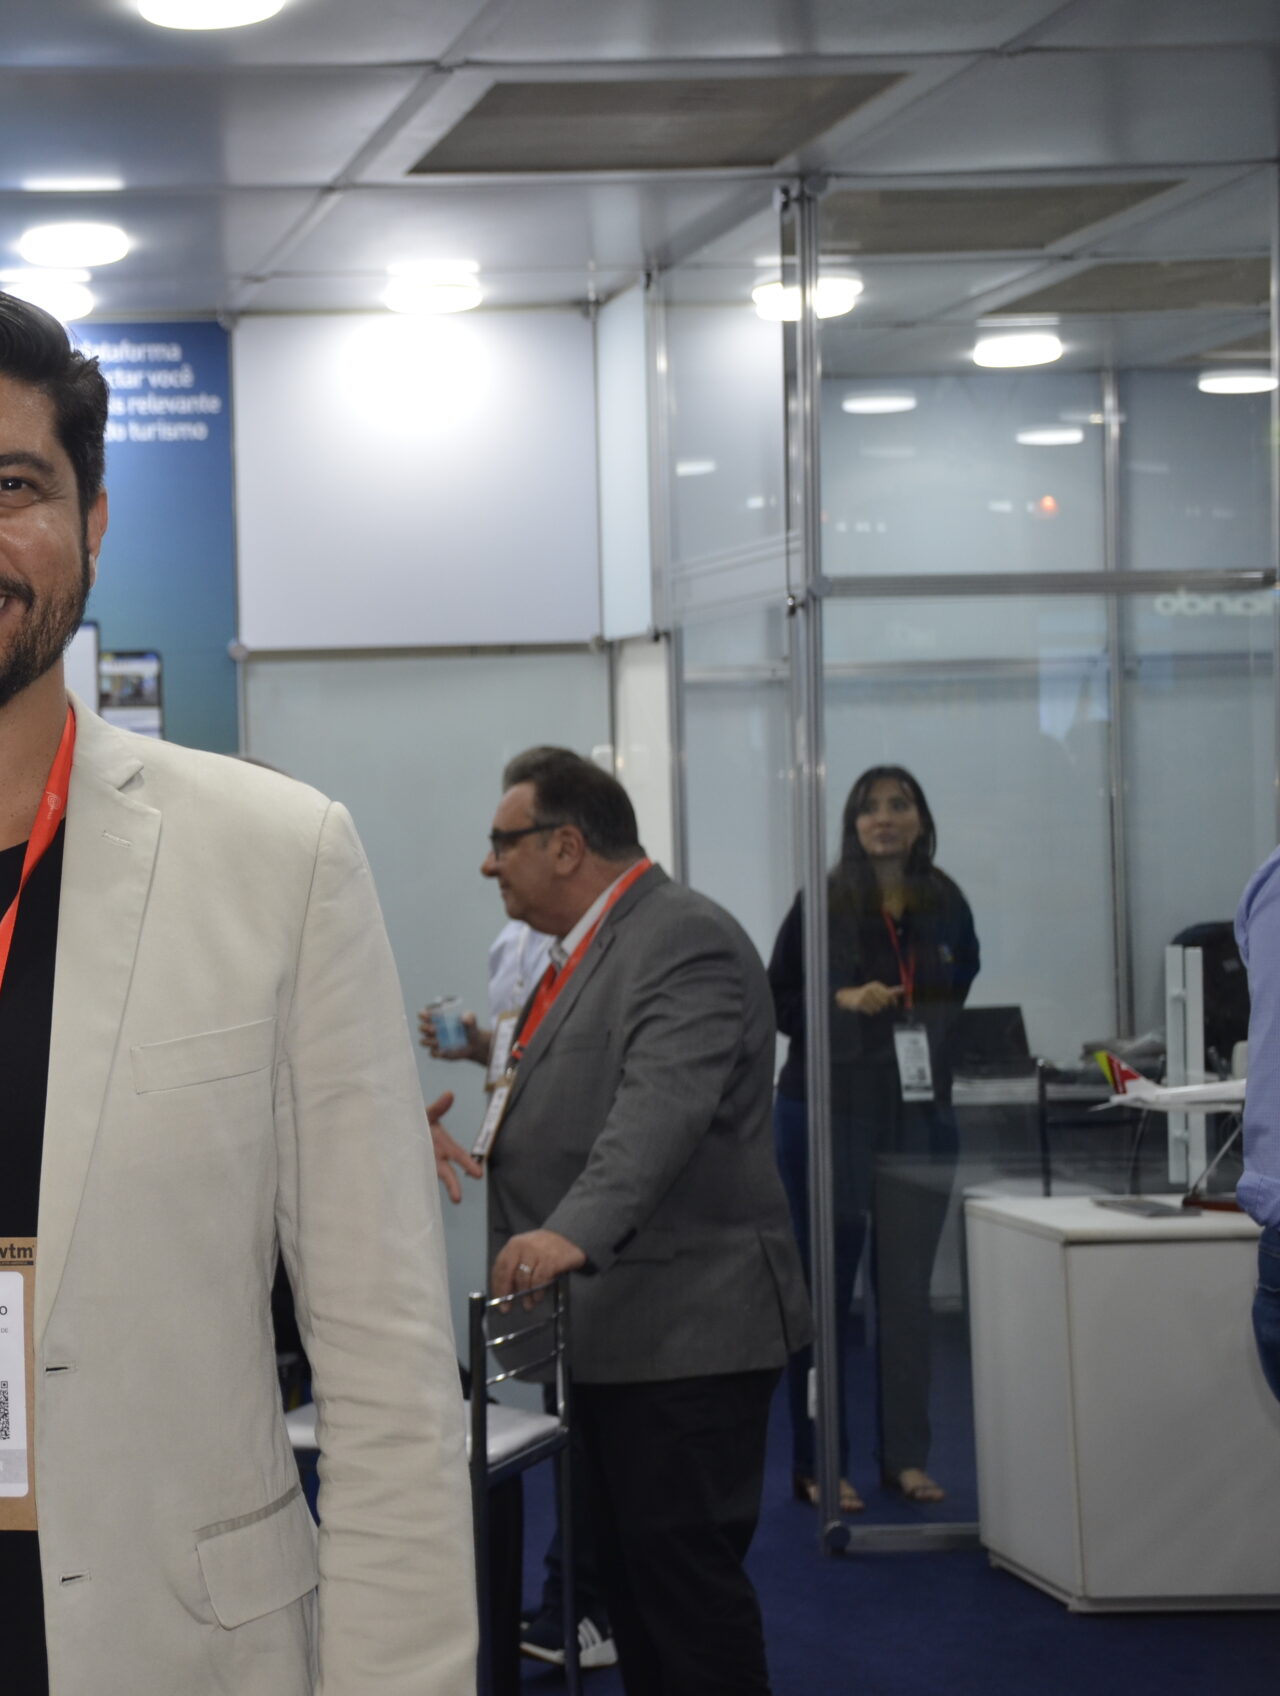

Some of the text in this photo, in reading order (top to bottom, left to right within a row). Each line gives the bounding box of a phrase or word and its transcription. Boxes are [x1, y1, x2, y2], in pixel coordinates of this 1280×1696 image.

[146, 364, 194, 389] você
[127, 391, 221, 416] relevante
[127, 418, 208, 442] turismo
